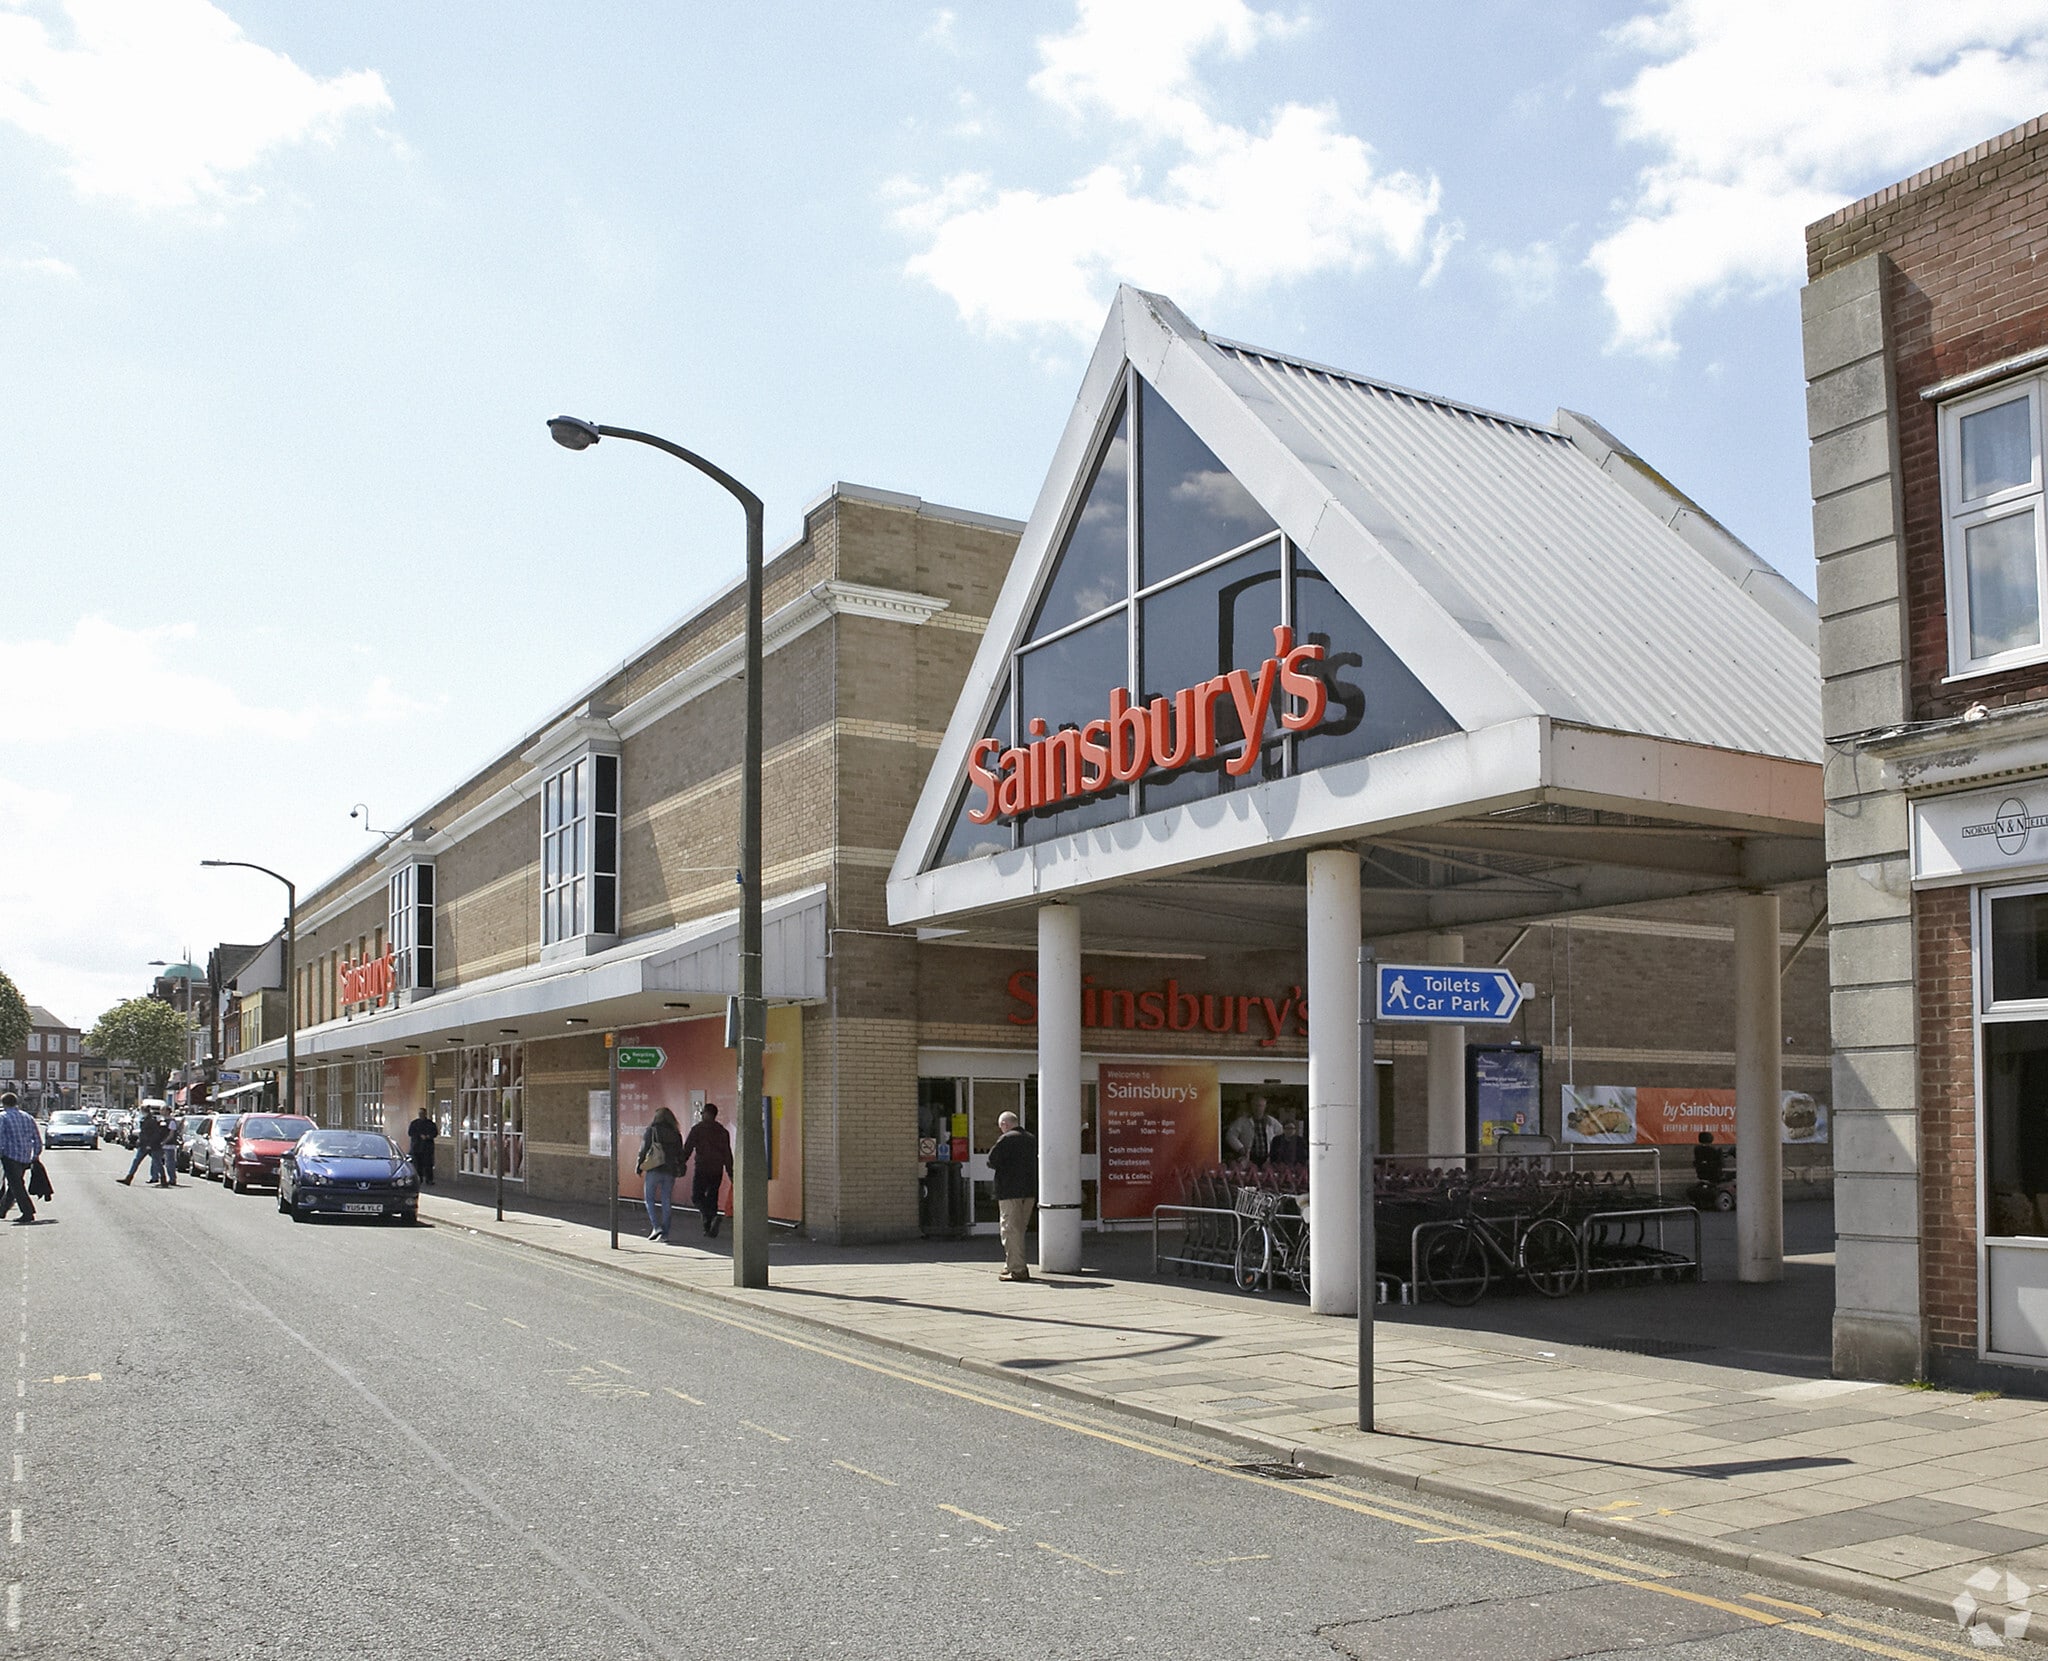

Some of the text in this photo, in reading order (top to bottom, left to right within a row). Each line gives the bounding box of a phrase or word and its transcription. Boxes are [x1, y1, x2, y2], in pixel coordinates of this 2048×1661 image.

[967, 624, 1326, 825] Sainsbury's
[340, 941, 396, 1007] Sainsbury's
[1423, 976, 1481, 993] Toilets
[1006, 970, 1309, 1048] Sinsbury'
[1413, 994, 1490, 1012] Car Park
[1107, 1071, 1150, 1079] Welcome to
[1107, 1082, 1198, 1103] Sainsbury's
[1663, 1101, 1679, 1122] by
